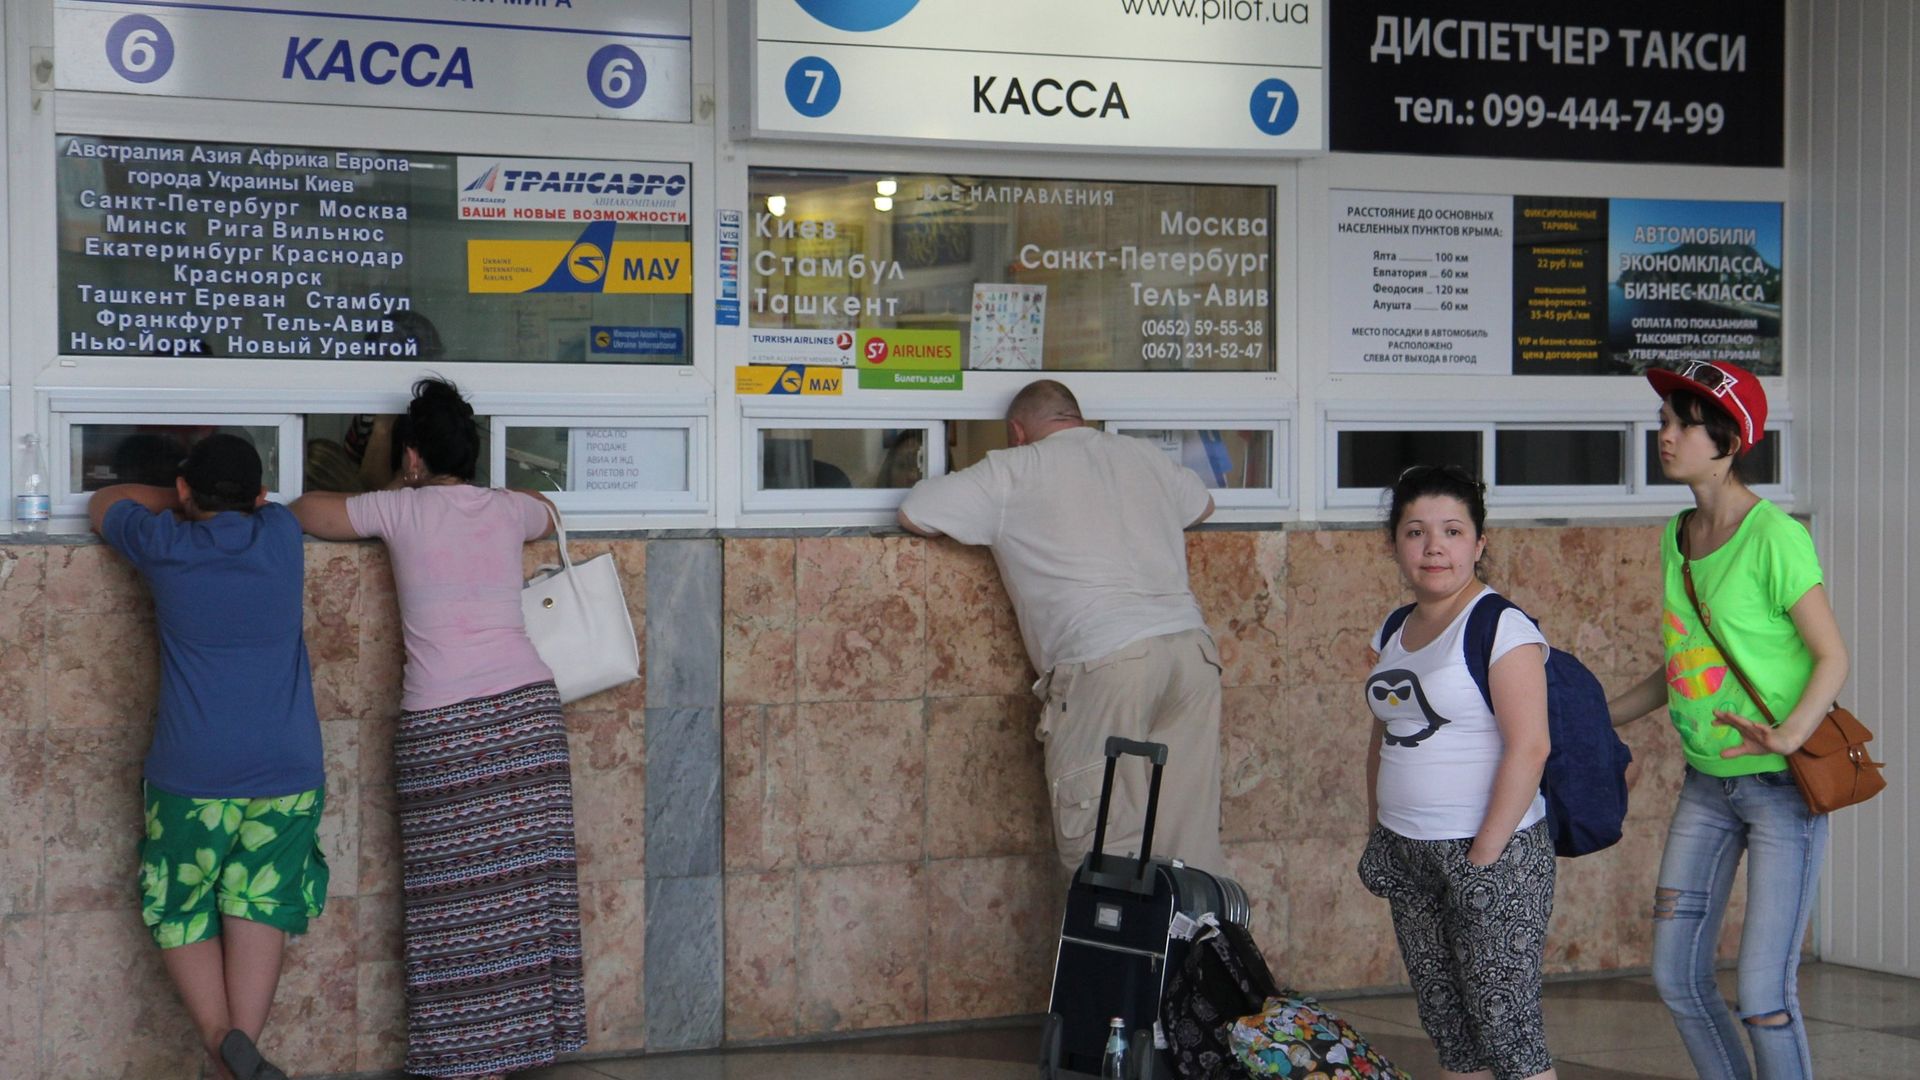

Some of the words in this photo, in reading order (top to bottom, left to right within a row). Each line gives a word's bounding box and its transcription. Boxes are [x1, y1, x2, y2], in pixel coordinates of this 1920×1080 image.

[1122, 0, 1309, 25] www.pilot.ua
[120, 28, 159, 73] 6
[1370, 15, 1610, 65] ДИСПЕТЧЕР
[1619, 29, 1747, 73] ТАКСИ
[281, 35, 475, 90] КАССА
[600, 57, 634, 98] 6
[804, 69, 825, 104] 7
[973, 75, 1130, 119] КАССА
[1266, 91, 1285, 124] 7
[1395, 96, 1474, 125] тел.:
[1483, 93, 1725, 135] 099-444-74-99
[66, 139, 185, 162] Австралия
[190, 146, 242, 165] Азия
[248, 149, 329, 171] Африка
[335, 152, 409, 172] Европа
[128, 171, 202, 189] города
[208, 171, 299, 191] Украины
[305, 174, 354, 193] Киев
[503, 170, 686, 196] ТРАНСАЭРО
[592, 197, 677, 208] АВИАКОМПАНИЯ
[923, 183, 961, 201] ВСЕ
[971, 187, 1115, 206] НАПРАВЛЕНИЯ
[80, 189, 300, 218] Санкт-Петербург
[319, 200, 408, 221] Москва
[1347, 207, 1416, 218] РАССТОЯНИЕ
[1418, 209, 1433, 220] ДО
[1435, 210, 1494, 220] ОСНОВНЫХ
[462, 206, 506, 218] ВАШИ
[514, 208, 566, 219] НОВЫЕ
[573, 208, 687, 223] ВОЗМОЖНОСТИ
[1161, 211, 1268, 236] Москва
[106, 215, 187, 236] Минск
[208, 219, 264, 239] Рига
[273, 222, 385, 242] Вильнюс
[755, 213, 837, 240] Киев
[1338, 223, 1409, 234] НАСЕЛЕННЫХ
[1412, 225, 1460, 236] ПУНКТОВ
[1462, 227, 1503, 237] КРЫМА:
[1634, 227, 1756, 245] АВТОМОБИЛИ
[85, 238, 264, 262] Екатеринбург
[272, 244, 404, 268] Краснодар
[1020, 244, 1269, 277] Санкт-Петербург
[1373, 251, 1397, 261] Ялта
[1435, 253, 1453, 262] 100
[754, 250, 905, 284] Стамбул
[1537, 259, 1549, 268] 22
[1620, 254, 1769, 276] ЭКОНОМКЛАССА,
[174, 264, 322, 286] Красноярск
[1373, 267, 1428, 279] Евпатория
[1441, 269, 1453, 278] 60
[1130, 282, 1269, 307] Тель-Авив
[1373, 283, 1423, 295] Феодосия
[1435, 285, 1453, 294] 120
[1625, 282, 1765, 301] БИЗНЕС-КЛАССА
[78, 284, 187, 305] Ташкент
[196, 288, 286, 311] Ереван
[306, 291, 411, 314] Стамбул
[754, 288, 898, 317] Ташкент
[1373, 300, 1412, 312] Алушта
[1441, 302, 1453, 311] 60
[96, 309, 243, 333] Франкфурт
[263, 312, 394, 334] Тель-Авив
[1531, 310, 1555, 319] 35-45
[1141, 319, 1190, 337] (0652)
[1194, 320, 1263, 337] 59-55-38
[1352, 328, 1380, 336] МЕСТО
[1382, 328, 1422, 338] ПОСАДКИ
[1424, 329, 1429, 337] В
[1431, 329, 1488, 338] АВТОМОБИЛЬ
[1632, 318, 1671, 328] ОПЛАТА
[1674, 318, 1688, 328] ПО
[1690, 319, 1758, 330] ПОКАЗАНИЯМ
[71, 330, 202, 355] Нью-Йорк
[228, 335, 311, 354] Новый
[320, 338, 418, 359] Уренгой
[752, 335, 792, 343] TURKISH
[794, 337, 834, 345] AIRLINES
[1388, 342, 1452, 350] РАСПОЛОЖЕНО
[1518, 337, 1531, 345] VIP
[1636, 334, 1700, 344] ТАКСОМЕТРА
[1702, 334, 1753, 344] СОГЛАСНО
[868, 342, 884, 359] S7
[893, 345, 952, 359] AIRLINES
[1141, 343, 1181, 360] (067)
[1186, 343, 1263, 359] 231-52-47
[1363, 354, 1390, 362] СЛЕВА
[1405, 355, 1440, 363] ВЫХОДА
[1449, 355, 1477, 364] ГОРОД
[1523, 351, 1544, 360] цена
[1546, 352, 1598, 360] договорная
[1629, 349, 1711, 360] УТВЕРЖДЕННЫМ
[1713, 350, 1760, 360] ТАРИФАМ
[894, 374, 927, 383] Билеты
[929, 375, 955, 384] здесь!
[586, 429, 613, 438] КАССА
[615, 430, 627, 438] ПО
[587, 443, 627, 452] ПРОДАЖЕ
[587, 456, 609, 464] АВИА
[621, 456, 633, 465] ЖД
[586, 469, 624, 477] БИЛЕТОВ
[626, 469, 639, 477] ПО
